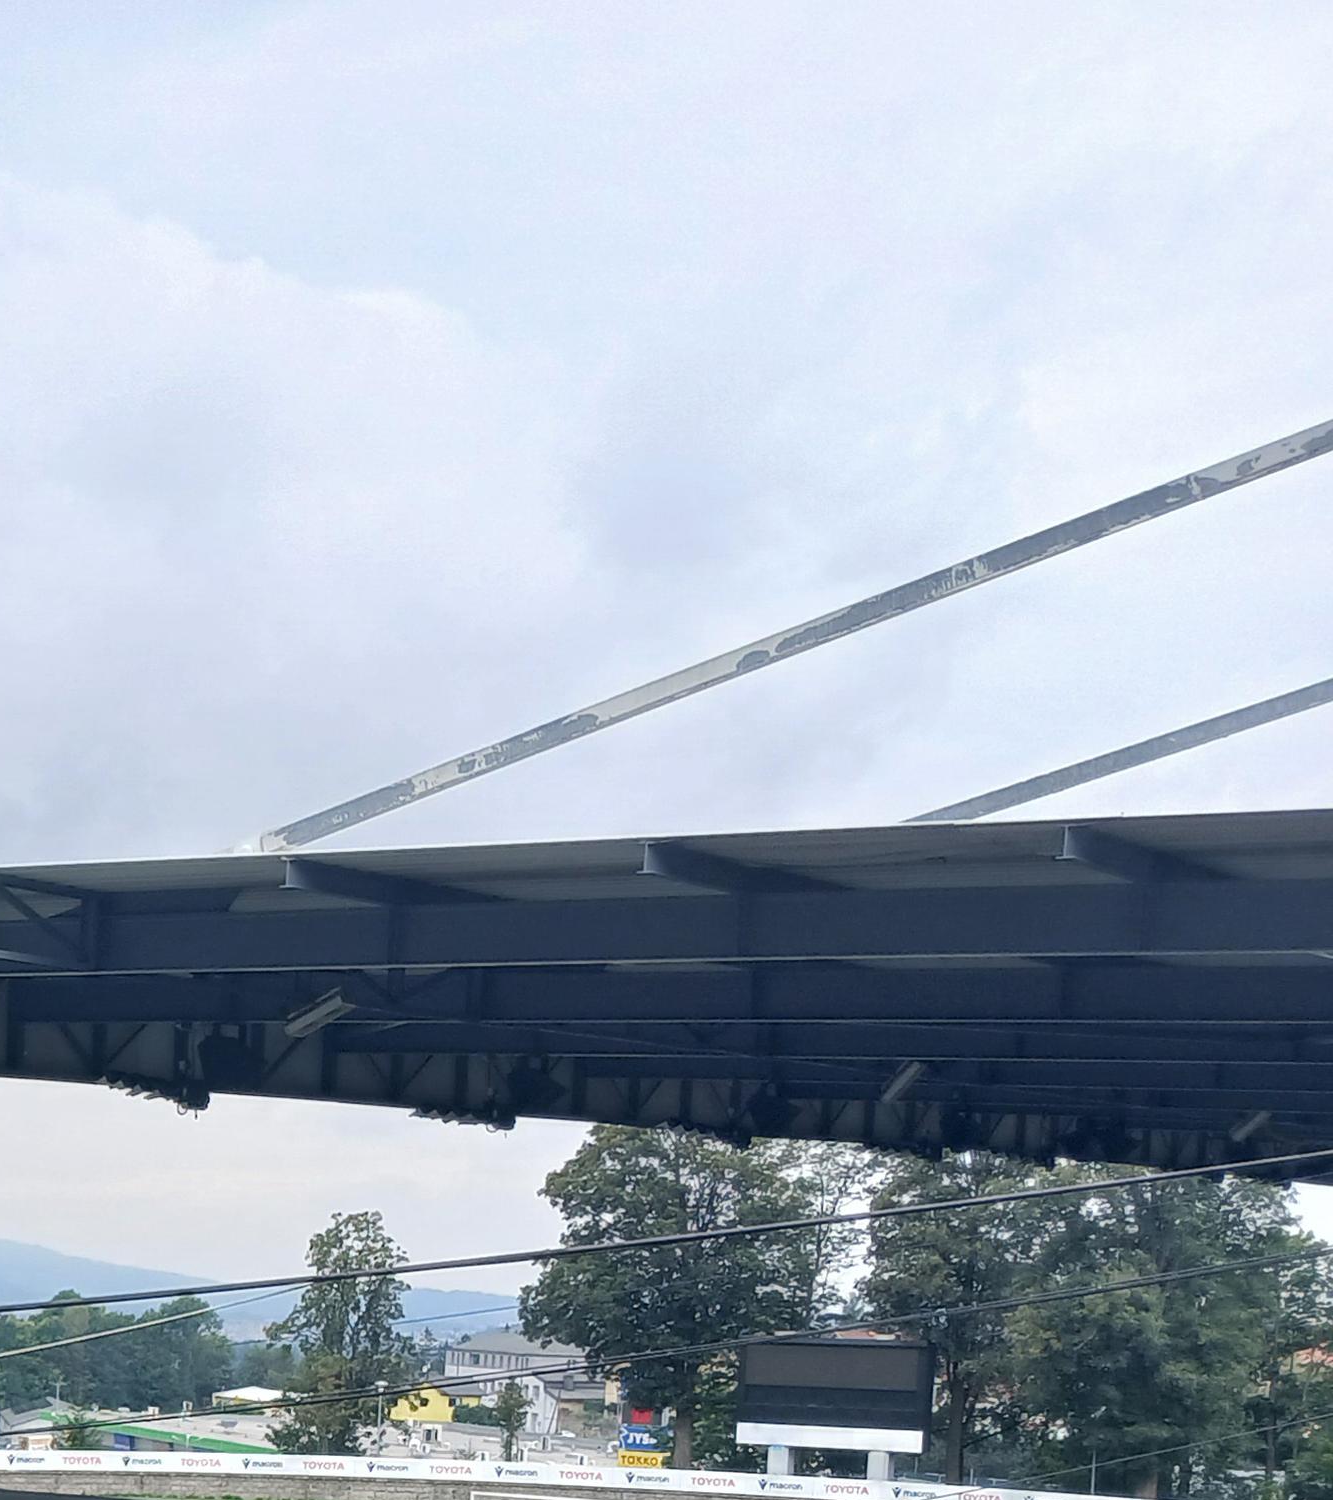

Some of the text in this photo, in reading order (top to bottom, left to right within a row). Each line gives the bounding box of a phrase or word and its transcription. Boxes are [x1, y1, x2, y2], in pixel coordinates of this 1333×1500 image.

[17, 1456, 46, 1464] macron
[62, 1456, 102, 1466] TOYOTA
[132, 1457, 162, 1466] macron
[181, 1458, 221, 1467] TOYOTA
[252, 1460, 283, 1468] macron
[303, 1461, 345, 1471] TOYOTA
[376, 1463, 409, 1472] macron
[429, 1465, 473, 1475] TOYOTA
[504, 1468, 538, 1477] macron
[558, 1470, 603, 1482] TOYOTA
[636, 1473, 670, 1484] macron
[691, 1476, 736, 1488] TOYOTA
[769, 1481, 803, 1491] macron
[824, 1483, 870, 1496] TOYOTA
[902, 1489, 937, 1499] macron
